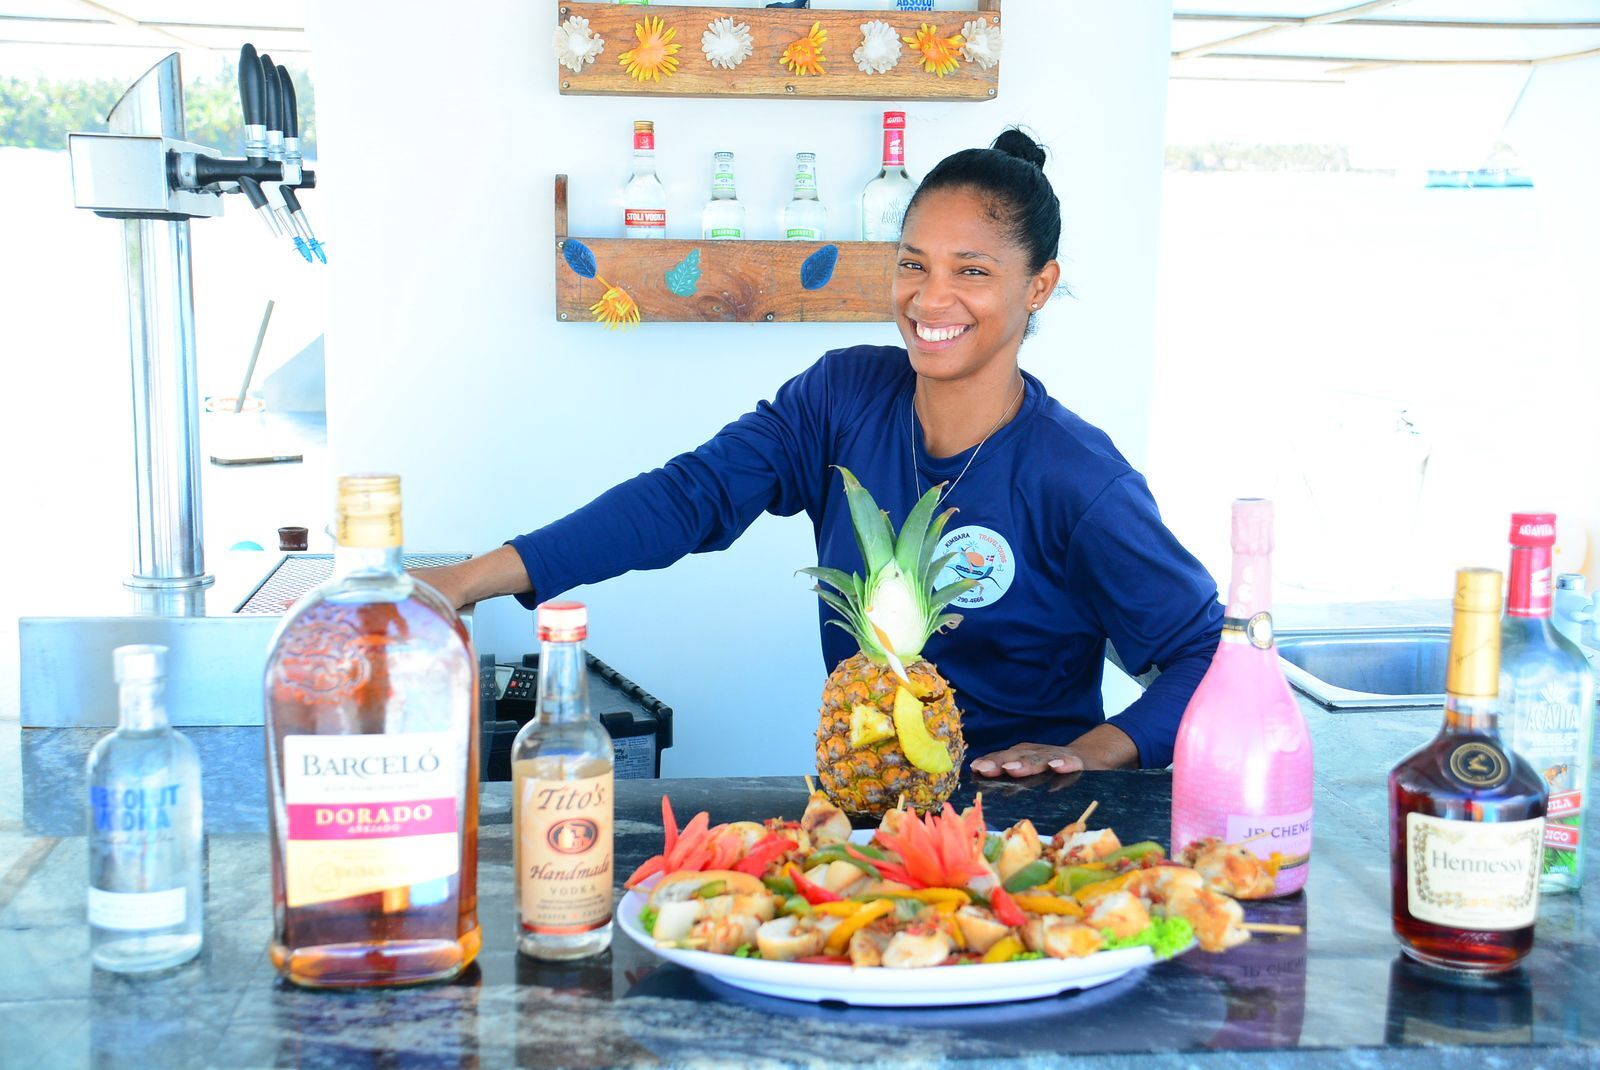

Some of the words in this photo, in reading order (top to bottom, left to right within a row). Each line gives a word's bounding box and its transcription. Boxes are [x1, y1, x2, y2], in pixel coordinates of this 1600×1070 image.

[627, 213, 645, 221] STOLI
[645, 213, 664, 222] VODKA
[944, 532, 971, 548] KIMBARA
[301, 747, 440, 779] BARCELÓ
[314, 804, 433, 826] DORADO
[1431, 849, 1525, 874] Hennessy
[550, 884, 597, 896] VODKA
